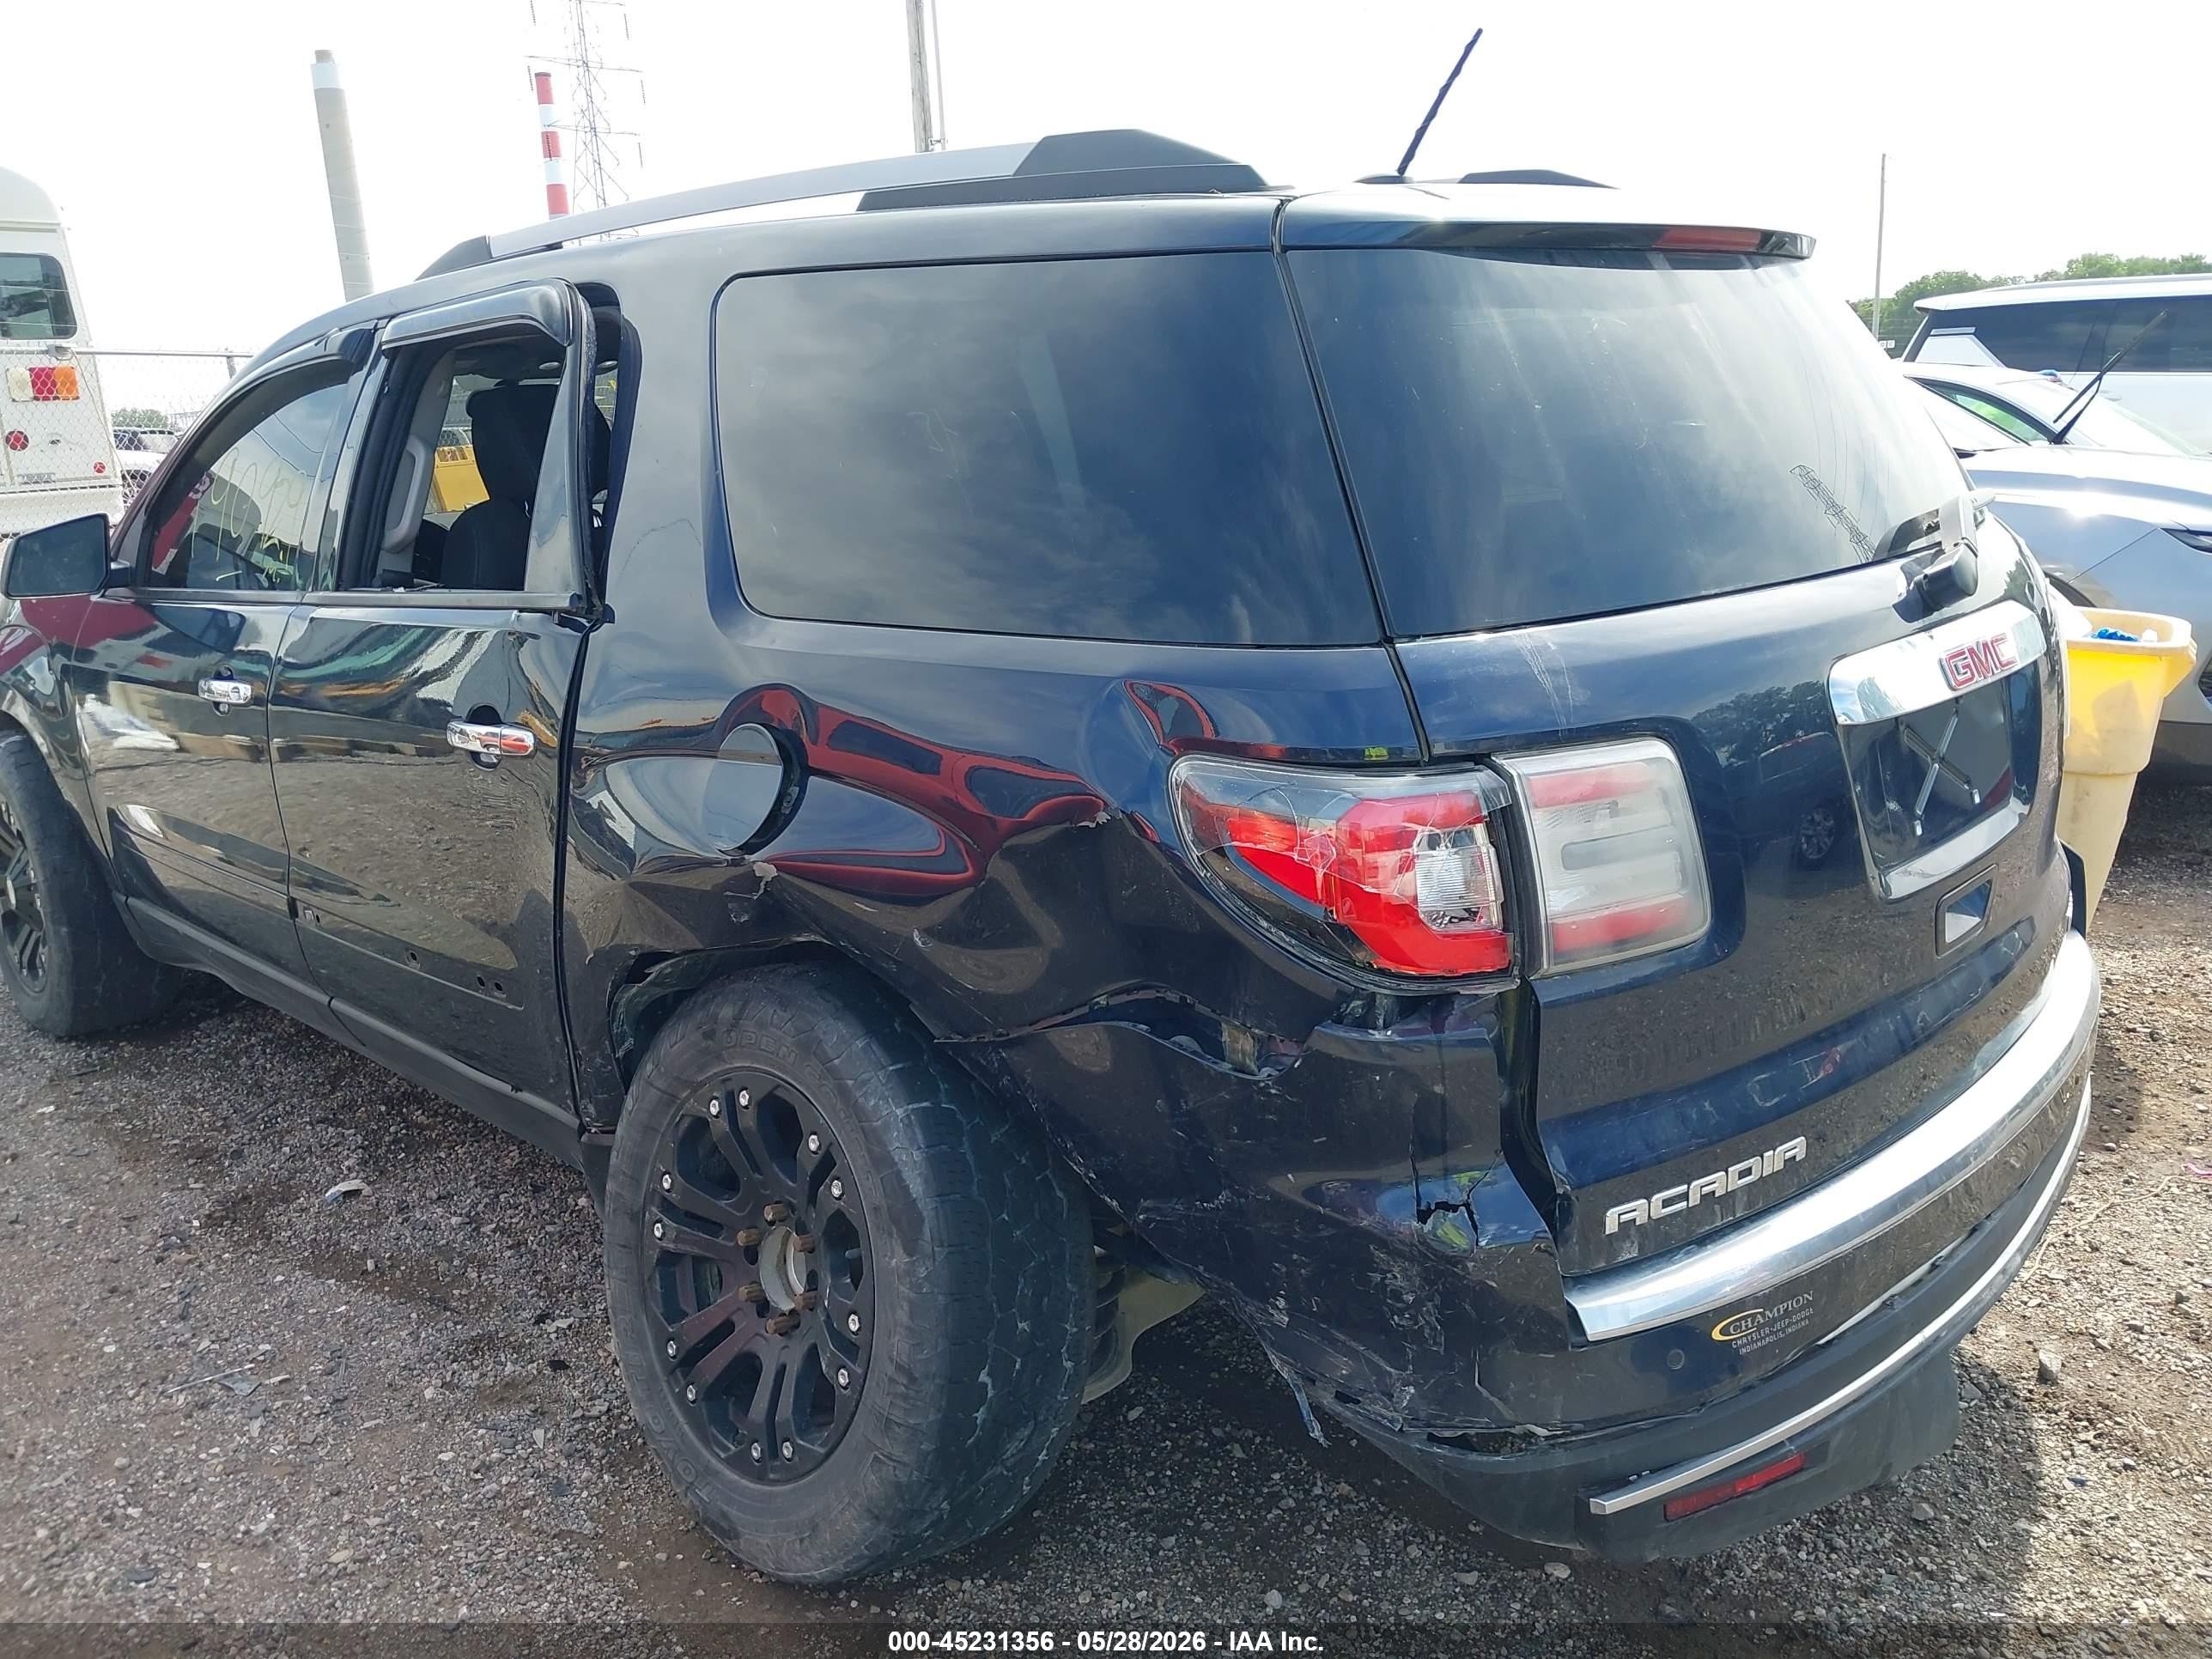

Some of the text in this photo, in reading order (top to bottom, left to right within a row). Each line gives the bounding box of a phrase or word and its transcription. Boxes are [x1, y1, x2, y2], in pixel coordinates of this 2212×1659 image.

[1944, 633, 2017, 688] GMC
[1604, 1135, 1807, 1236] ACADIA
[1729, 1290, 1814, 1335] CHAMPION
[1786, 1319, 1809, 1334] INDIANA
